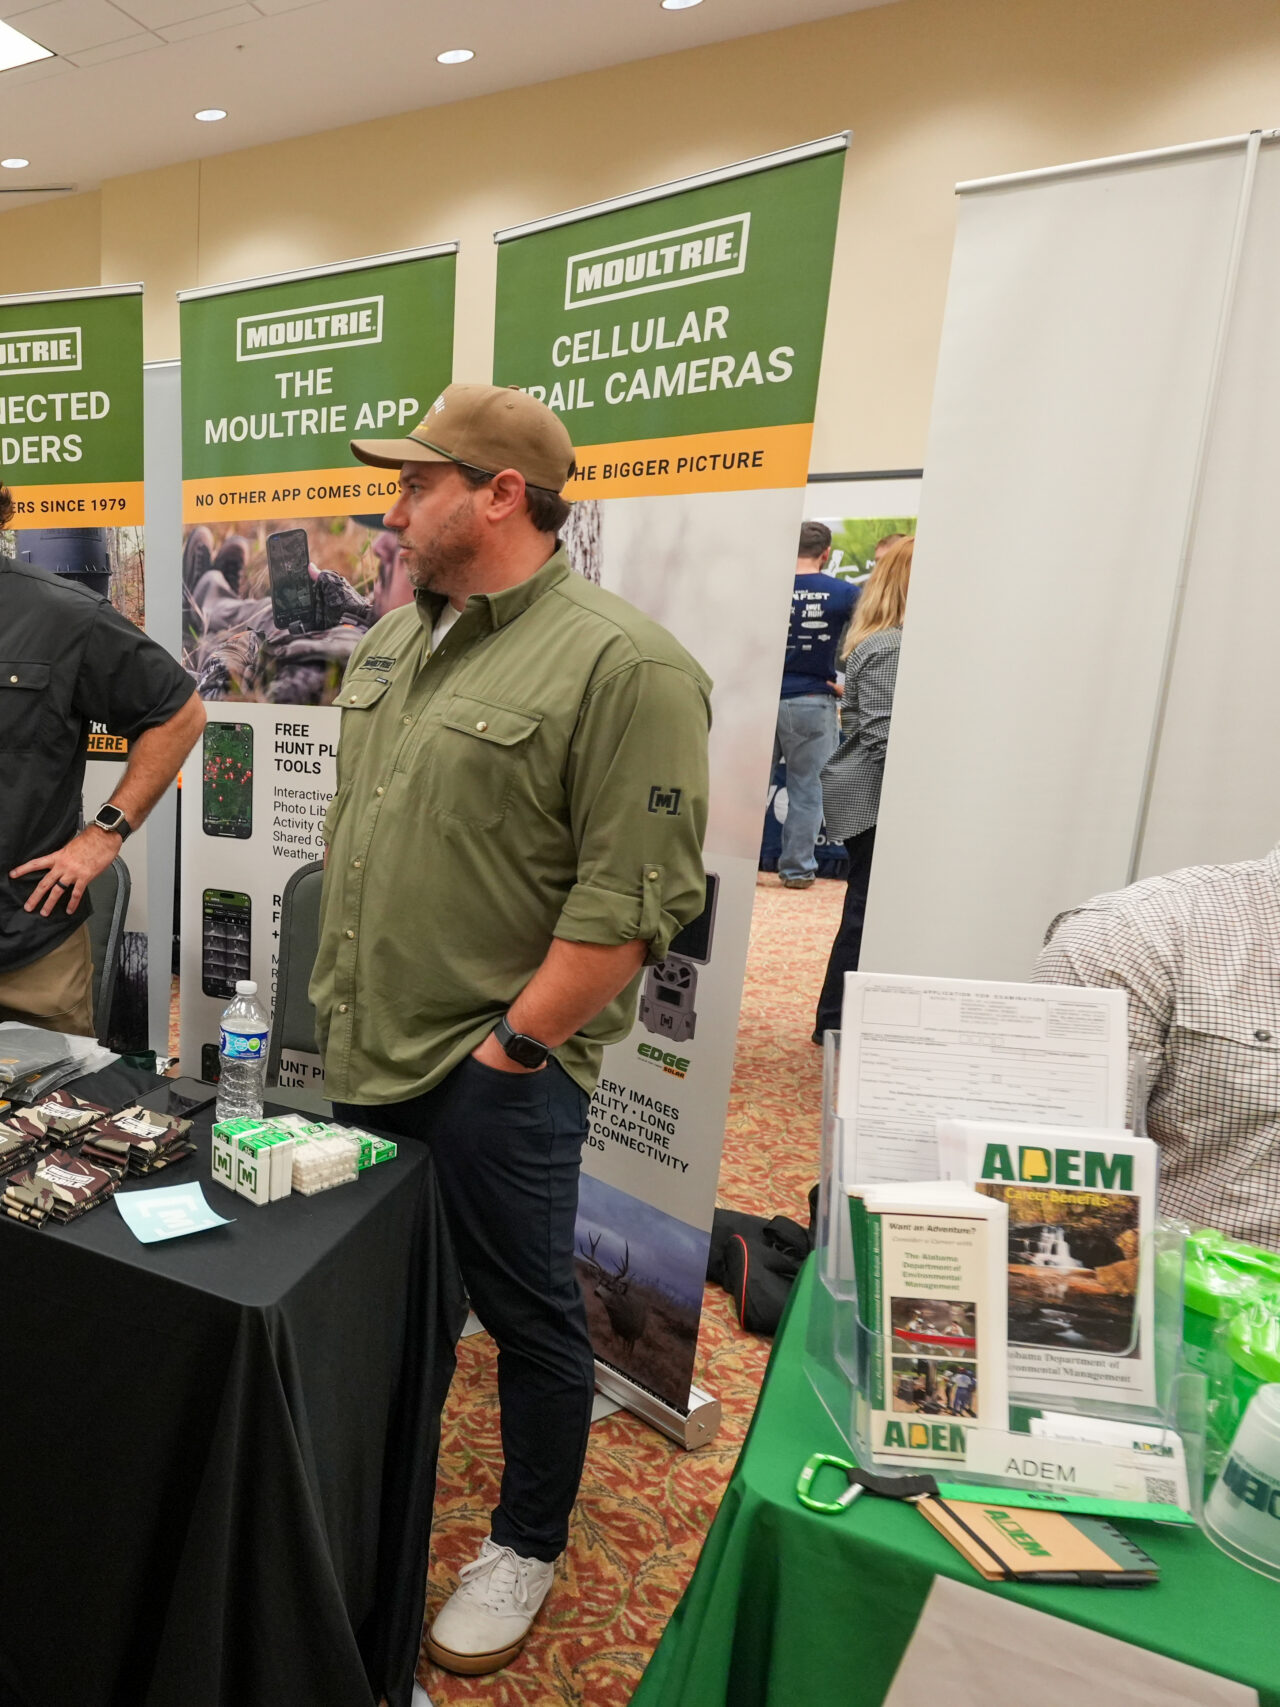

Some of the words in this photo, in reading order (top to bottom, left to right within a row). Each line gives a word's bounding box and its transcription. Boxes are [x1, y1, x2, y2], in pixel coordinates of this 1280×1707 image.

[576, 232, 738, 293] MOULTRIE
[247, 310, 376, 349] MOULTRIE
[552, 306, 729, 367] CELLULAR
[275, 367, 333, 398] THE
[605, 346, 795, 404] CAMERAS
[205, 405, 347, 444] MOULTRIE
[354, 398, 419, 431] APP
[570, 465, 597, 481] HE
[603, 459, 669, 479] BIGGER
[677, 450, 764, 472] PICTURE
[41, 499, 86, 513] SINCE
[91, 498, 126, 511] 1979
[196, 494, 214, 507] NO
[219, 491, 266, 505] OTHER
[272, 488, 301, 502] APP
[307, 484, 361, 500] COMES
[275, 723, 309, 737] FREE
[274, 741, 314, 757] HUNT
[274, 759, 321, 774] TOOLS
[274, 786, 333, 801] Interactive
[274, 801, 306, 814] Photo
[273, 817, 314, 833] Activity
[273, 831, 311, 845] Shared
[273, 845, 318, 861] Weather
[637, 1043, 690, 1072] EDGE
[663, 1066, 685, 1079] SOLAR
[597, 1079, 625, 1096] ERY
[630, 1090, 679, 1120] IMAGES
[592, 1091, 628, 1114] ALITY
[641, 1110, 675, 1135] LONG
[589, 1105, 607, 1120] RT
[611, 1114, 670, 1149] CAPTURE
[586, 1136, 605, 1151] DS
[594, 1123, 688, 1173] CONNECTIVITY
[981, 1143, 1134, 1191] ADEM
[1005, 1187, 1048, 1201] Career
[1049, 1190, 1110, 1207] Benefits
[889, 1223, 911, 1231] Want
[927, 1225, 976, 1235] Adventure?
[1045, 1353, 1106, 1368] Department
[1063, 1368, 1131, 1383] Management
[1005, 1457, 1077, 1482] ADEM
